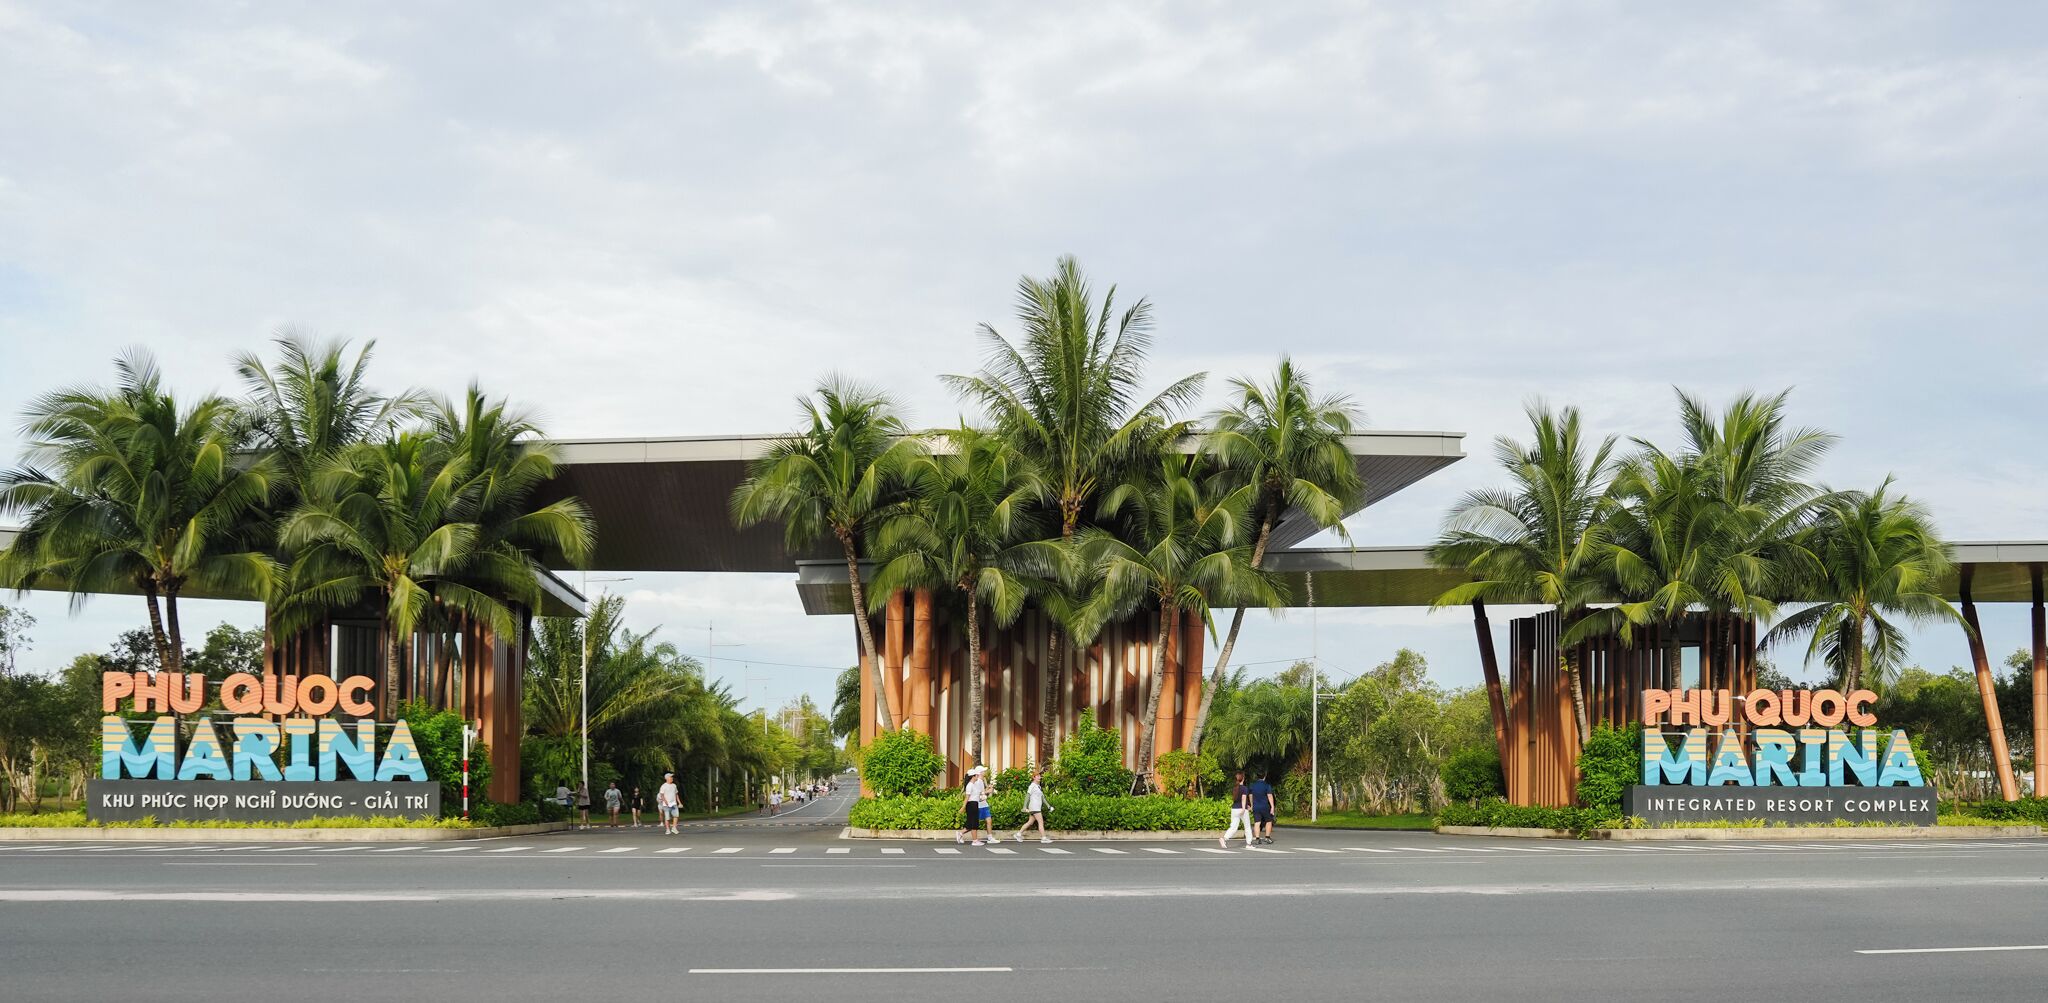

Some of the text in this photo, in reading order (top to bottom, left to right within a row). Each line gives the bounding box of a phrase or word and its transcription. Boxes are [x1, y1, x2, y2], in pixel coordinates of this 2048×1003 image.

[102, 671, 376, 716] PHU QUOC
[1643, 688, 1879, 728] PHU QUOC
[102, 716, 429, 782] MARINA
[1643, 728, 1925, 787] MARINA
[102, 794, 135, 808] KHU
[141, 792, 187, 808] PHỨC
[193, 794, 229, 811] HỢP
[235, 790, 276, 809] NGHỈ
[282, 792, 343, 809] DƯỠNG
[364, 791, 398, 809] GIẢI
[404, 793, 429, 809] TRÍ
[1647, 798, 1930, 813] INTEGRATED RESORT COMPLEX
